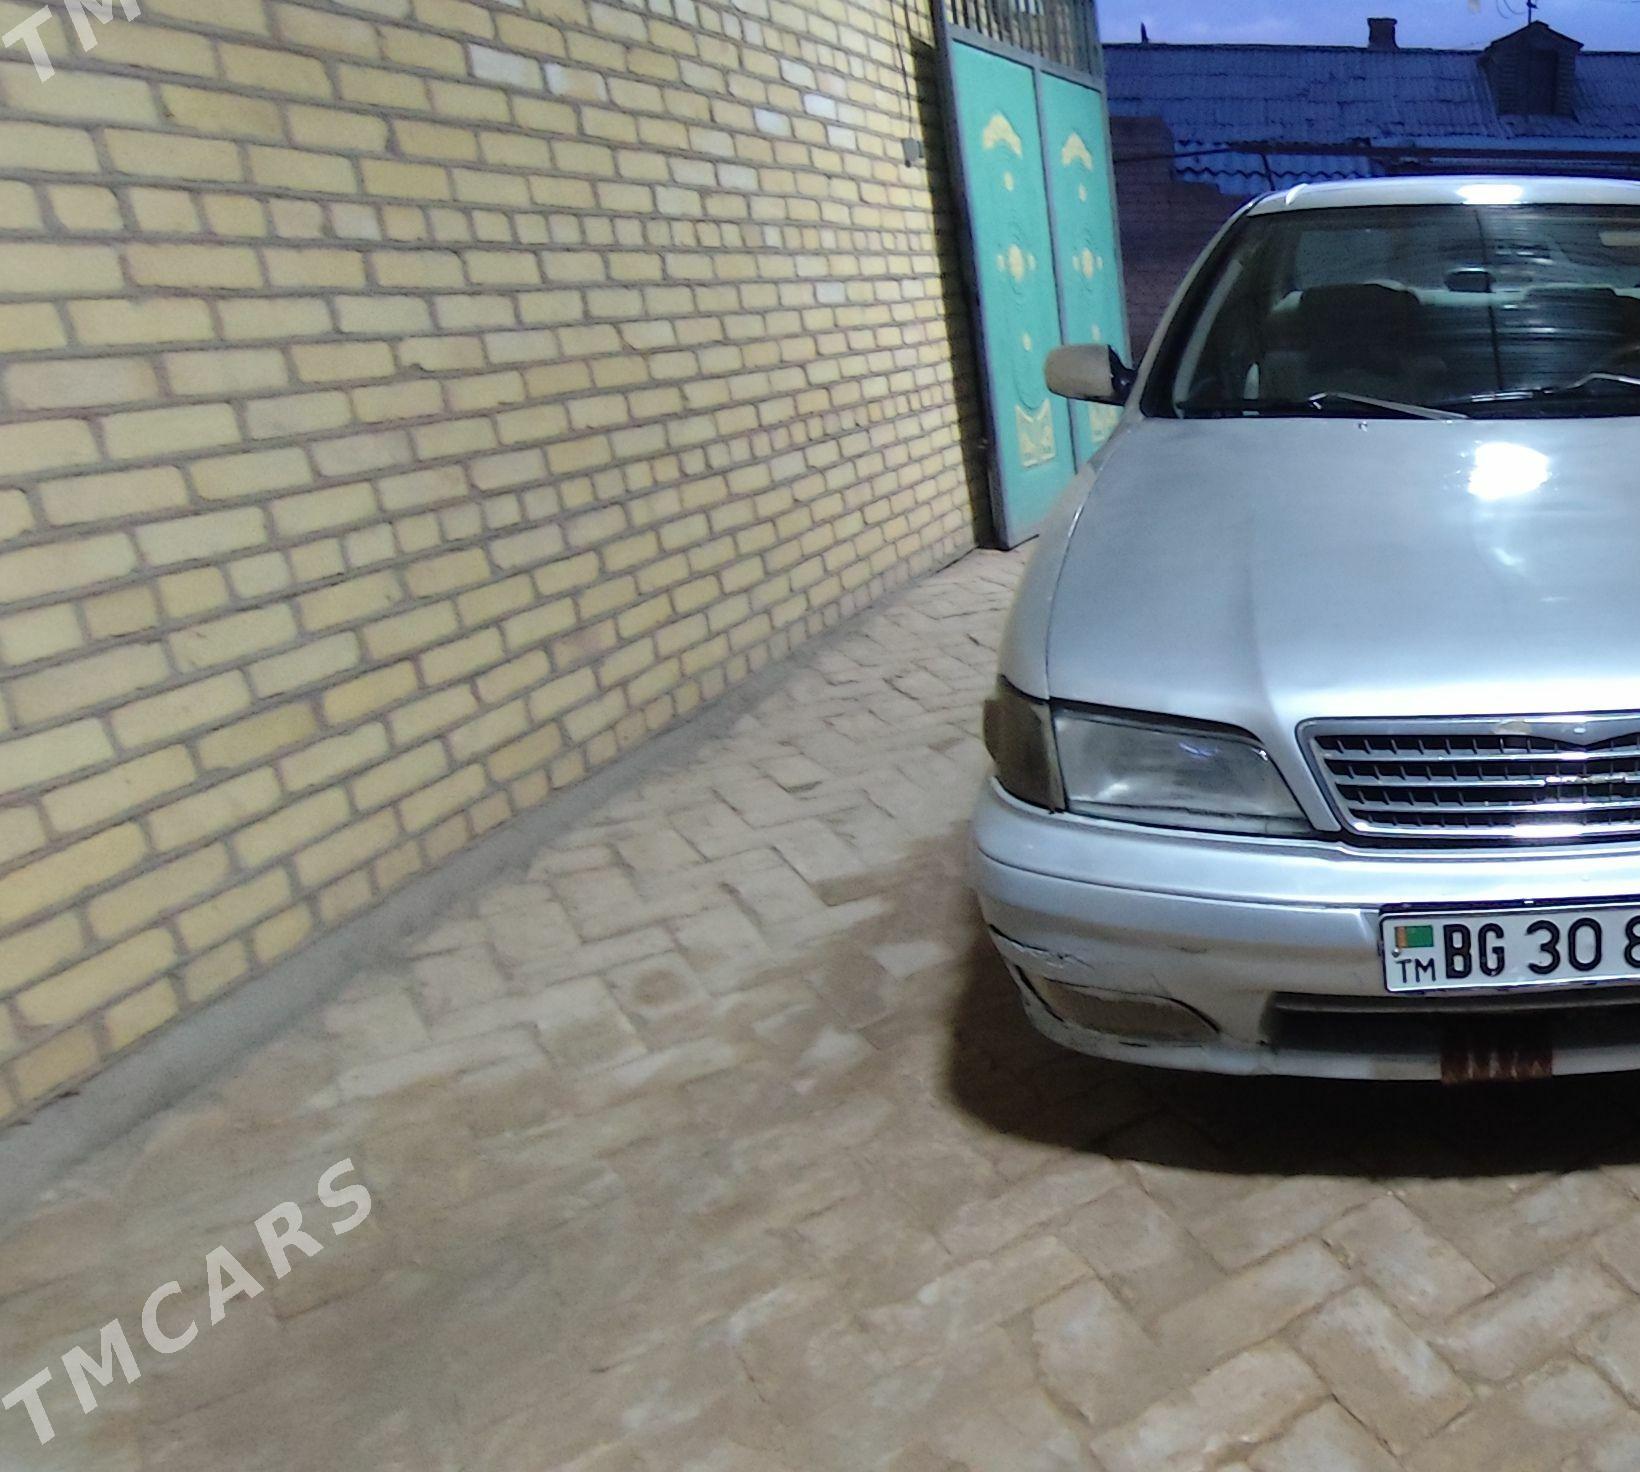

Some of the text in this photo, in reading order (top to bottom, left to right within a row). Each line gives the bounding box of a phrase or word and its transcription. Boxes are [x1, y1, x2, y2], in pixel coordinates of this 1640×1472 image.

[1395, 957, 1436, 984] TM
[1443, 922, 1505, 979] BG
[1525, 917, 1603, 976] 30
